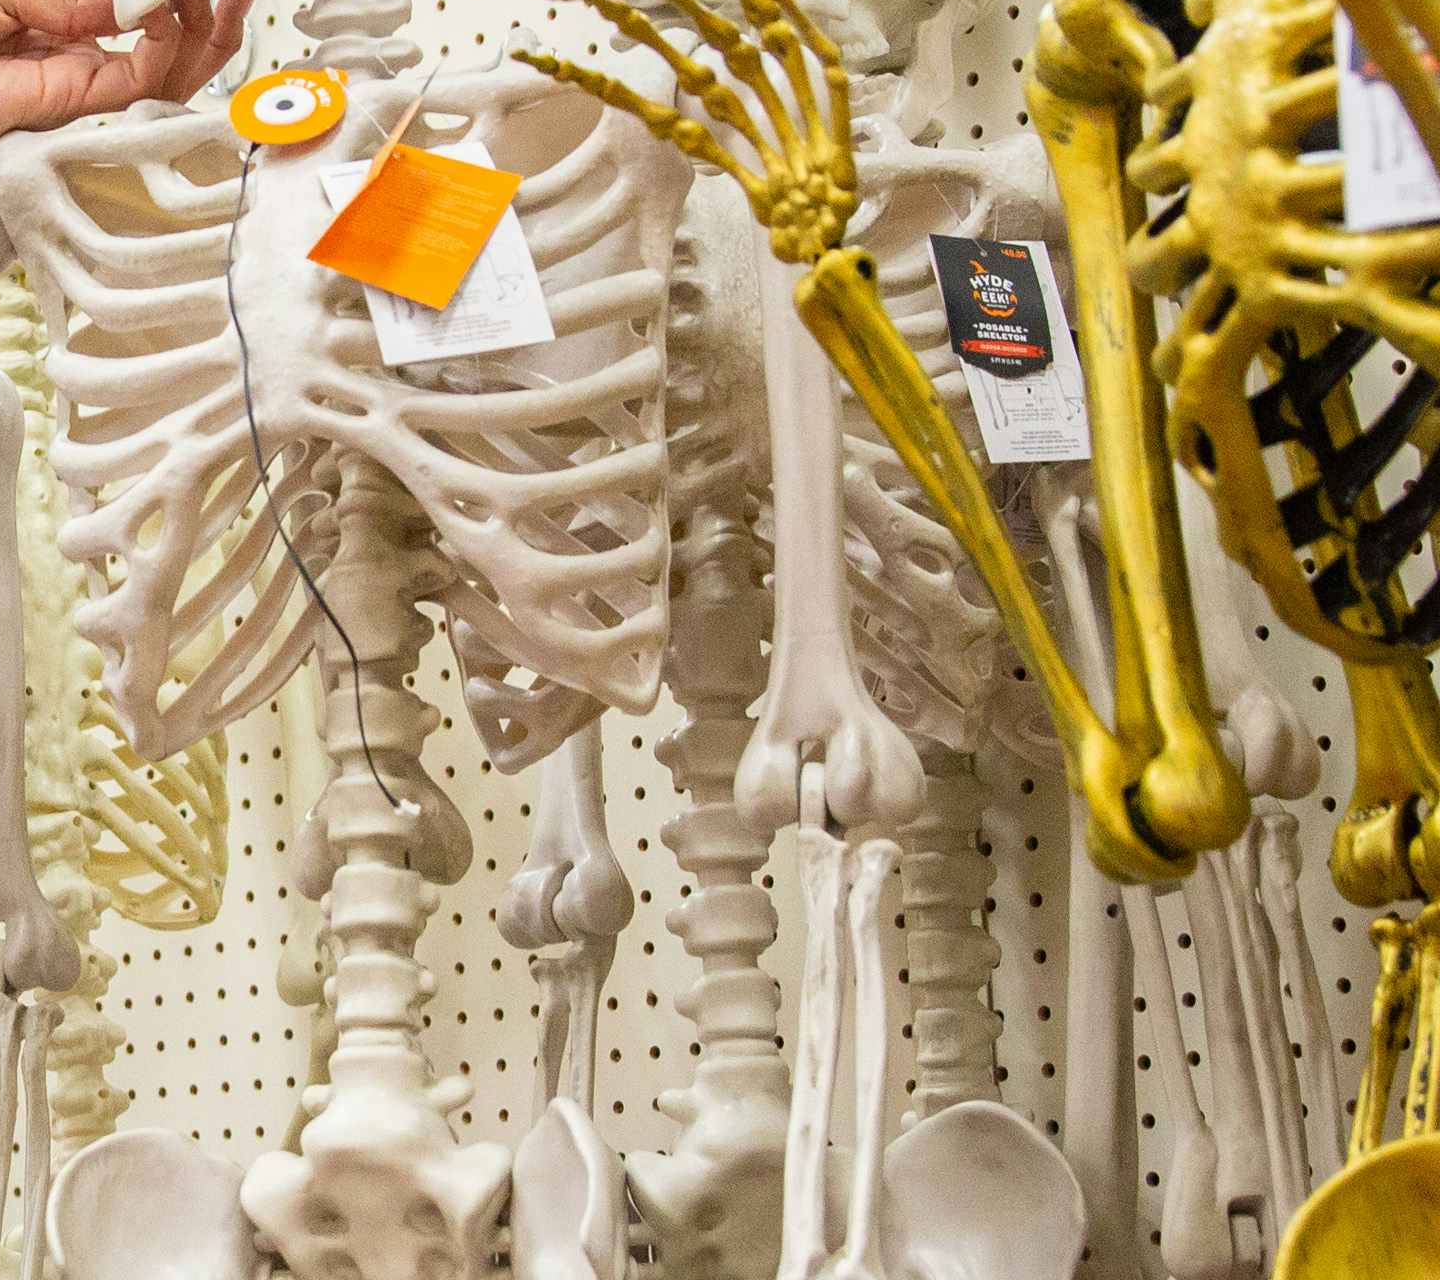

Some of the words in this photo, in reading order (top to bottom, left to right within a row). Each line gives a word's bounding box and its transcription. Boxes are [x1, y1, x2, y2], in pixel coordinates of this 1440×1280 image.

[283, 77, 319, 89] TRY
[969, 273, 1014, 293] HYDE
[980, 291, 1010, 305] EEK!
[978, 322, 1023, 333] POSABLE
[977, 331, 1027, 342] SKELETON
